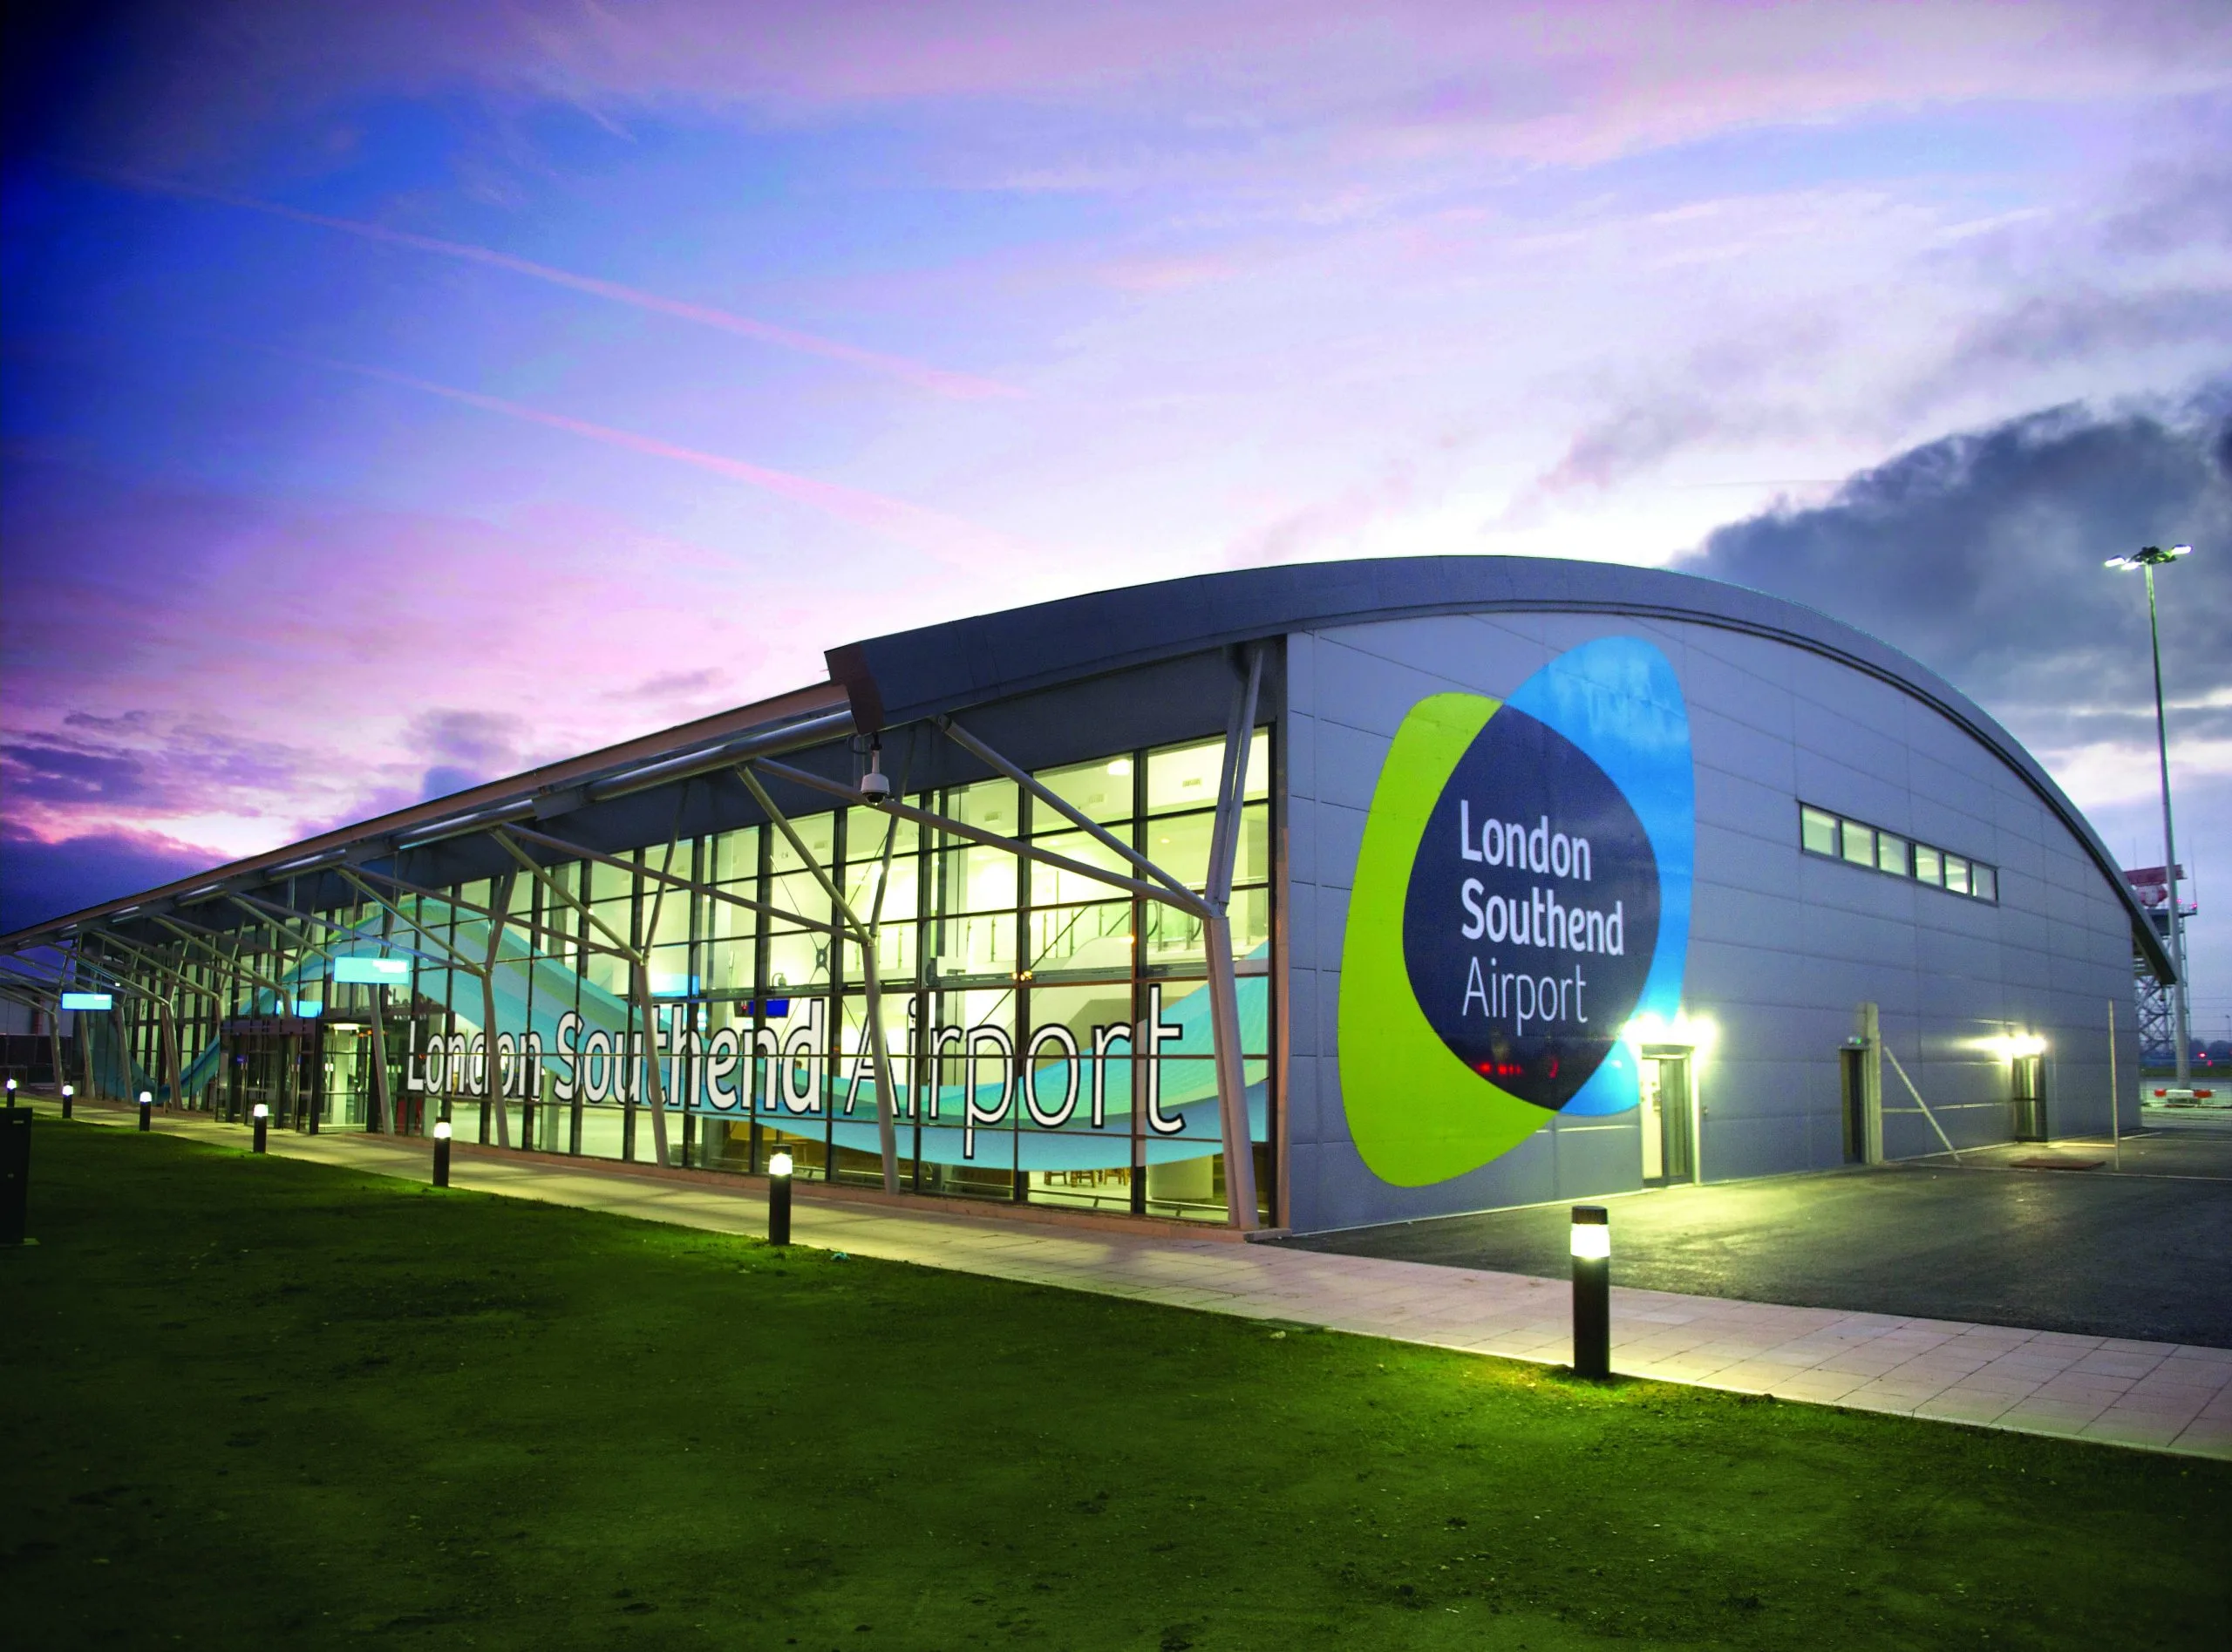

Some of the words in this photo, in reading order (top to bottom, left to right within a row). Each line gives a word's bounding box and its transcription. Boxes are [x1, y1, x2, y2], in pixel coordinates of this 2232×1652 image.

[1460, 799, 1591, 881] London
[1461, 878, 1623, 955] Southend
[1462, 956, 1589, 1037] Airport
[406, 1020, 542, 1098] London
[554, 997, 825, 1113] Southend
[843, 983, 1186, 1160] Airport
